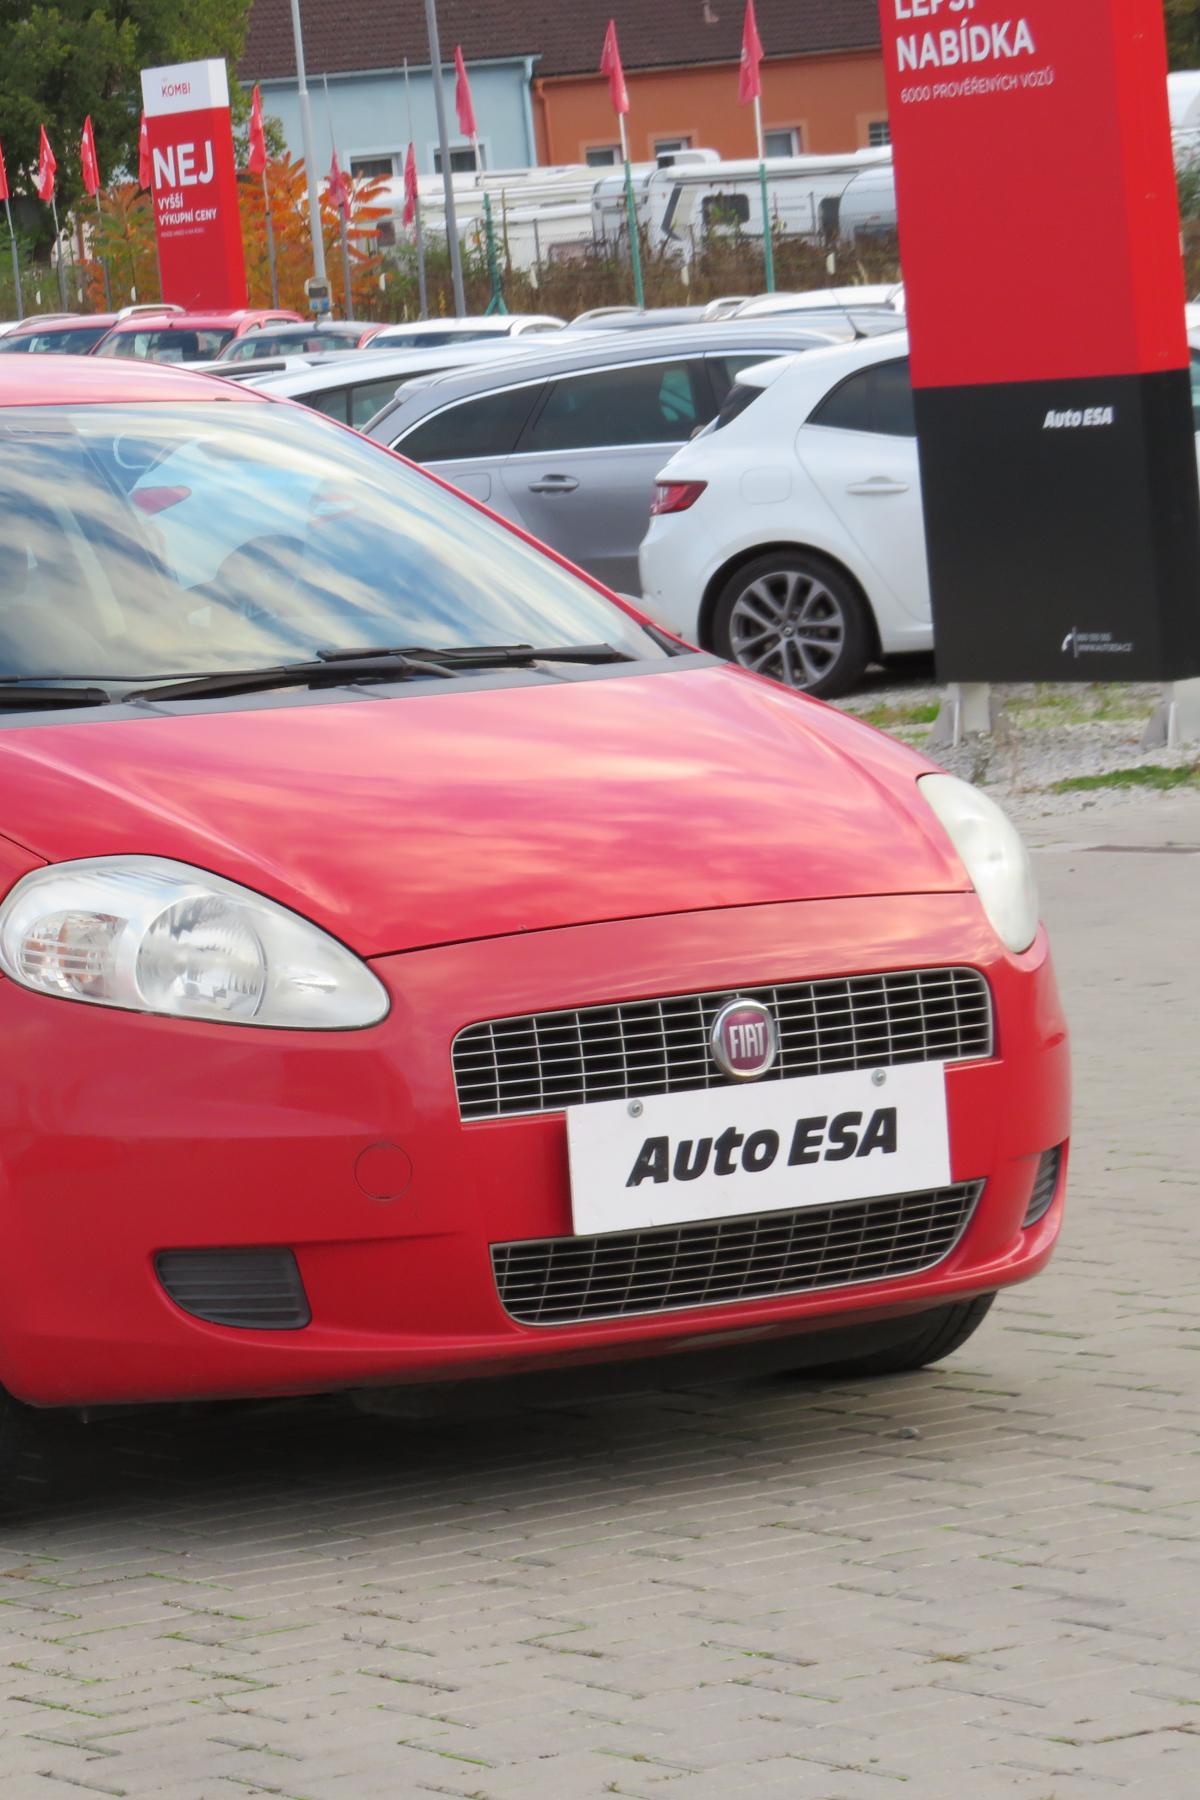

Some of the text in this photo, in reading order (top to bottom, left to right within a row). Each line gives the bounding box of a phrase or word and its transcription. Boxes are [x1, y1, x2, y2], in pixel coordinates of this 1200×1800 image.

[895, 17, 1036, 72] NABÍDKA
[161, 82, 191, 97] KOMBI
[900, 85, 931, 103] 6000
[152, 140, 214, 190] NEJ
[195, 208, 217, 222] CENY
[1042, 406, 1114, 429] Auto ESA
[728, 1021, 765, 1060] FIAT
[625, 1107, 897, 1187] Auto ESA
